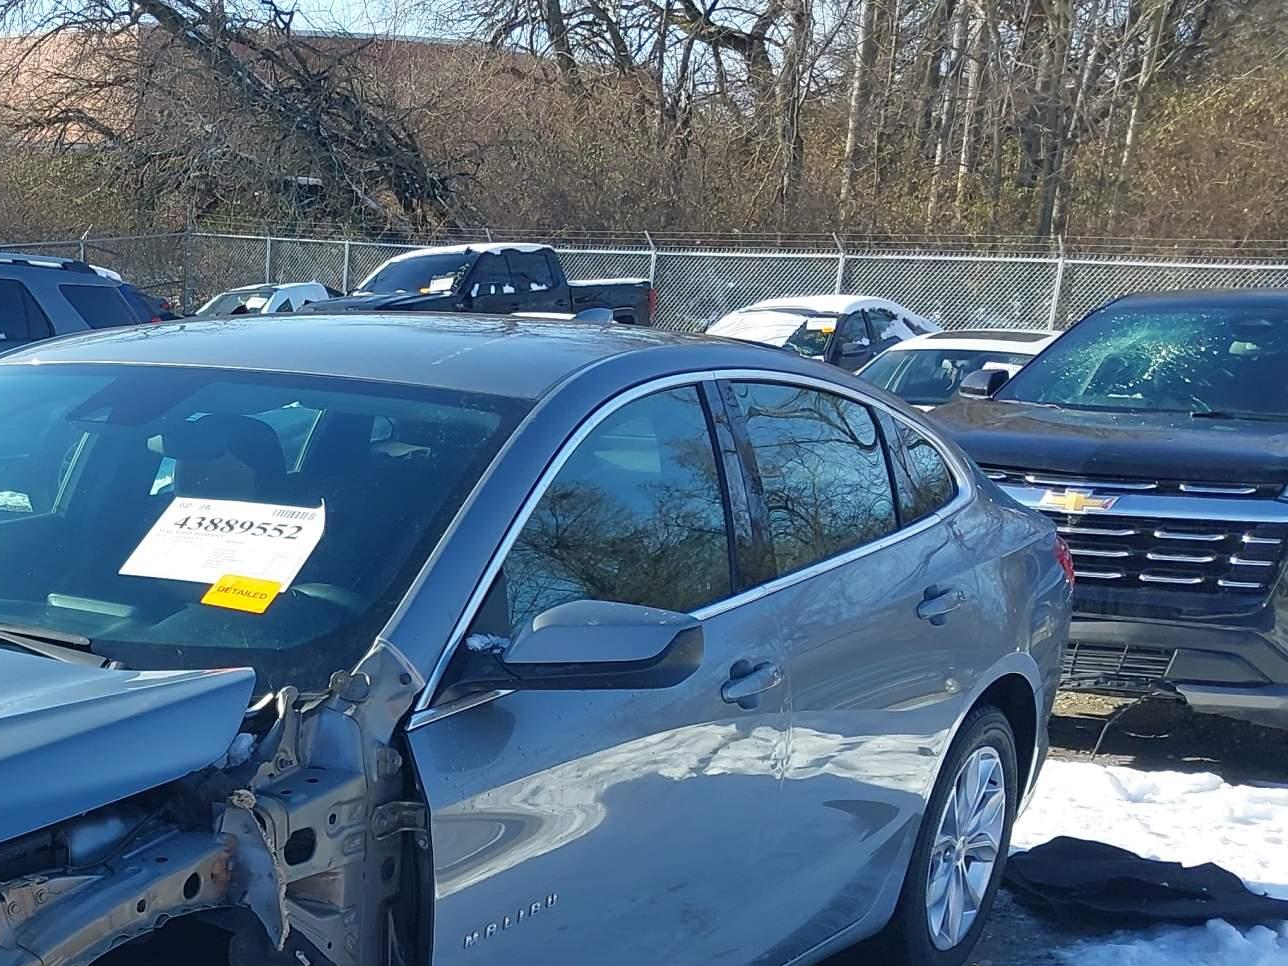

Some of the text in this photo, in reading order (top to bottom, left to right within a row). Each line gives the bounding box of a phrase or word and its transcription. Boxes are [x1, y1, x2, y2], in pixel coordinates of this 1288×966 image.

[175, 515, 304, 540] 43889552
[216, 584, 268, 601] DETAILED
[464, 892, 559, 949] MALIBU
